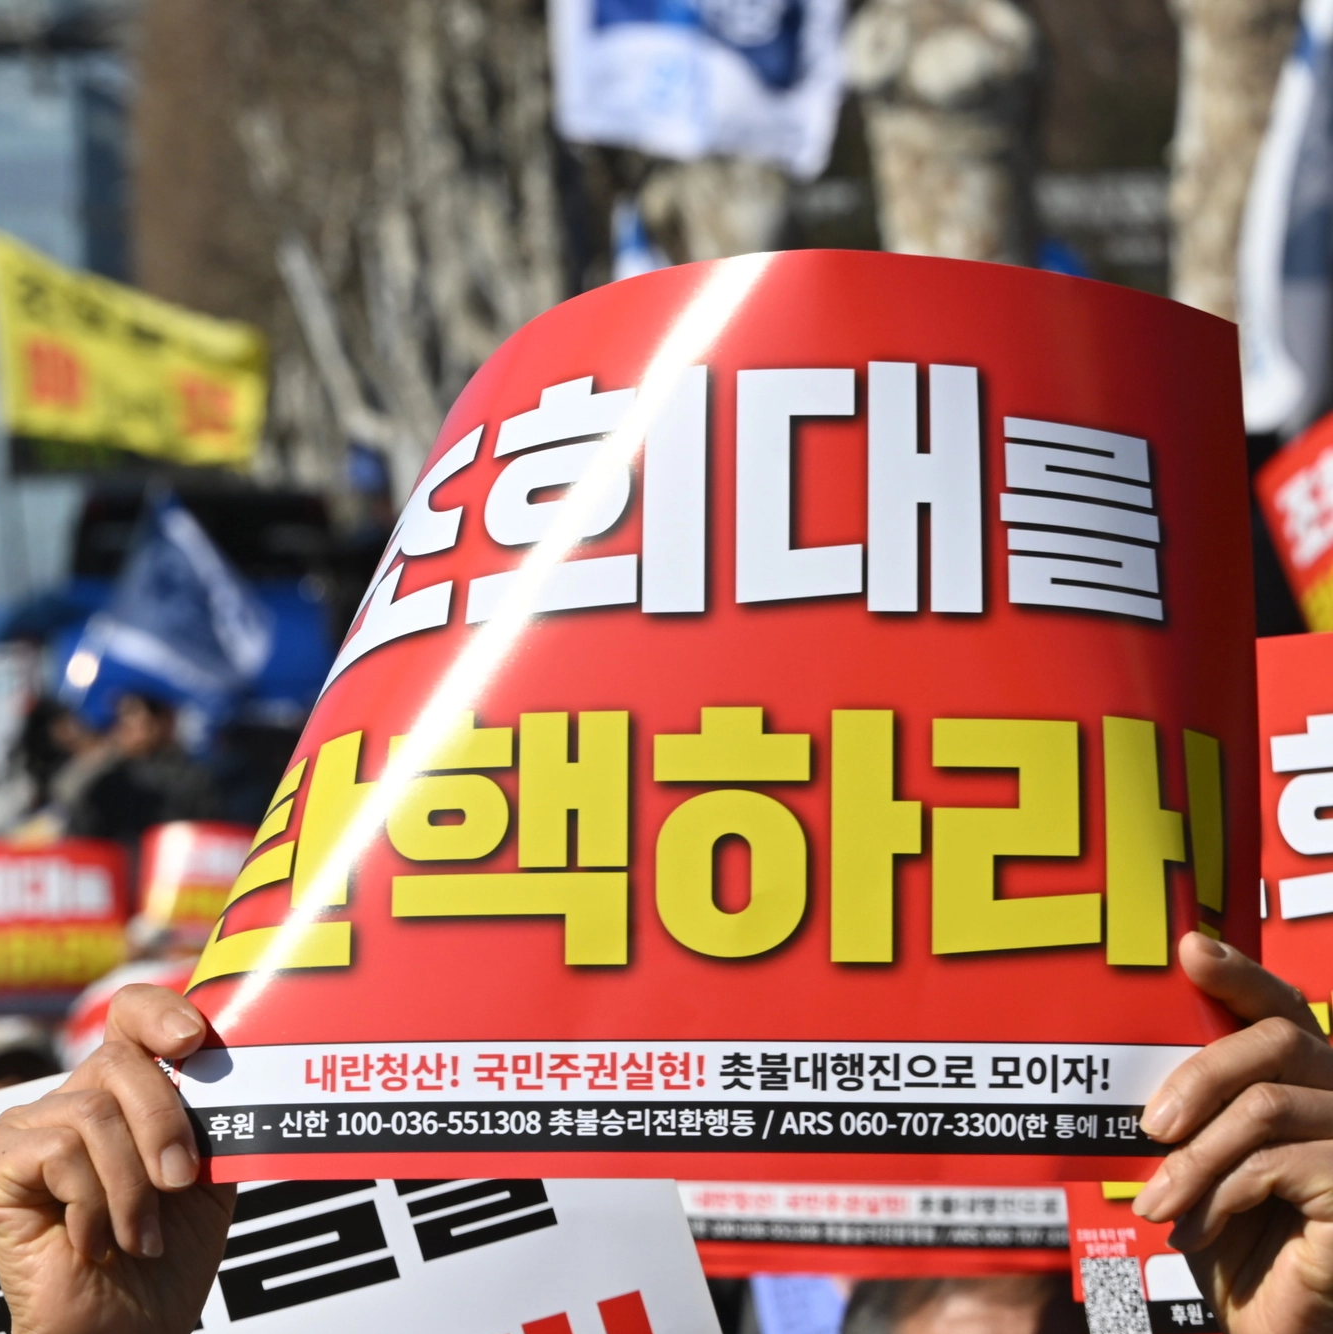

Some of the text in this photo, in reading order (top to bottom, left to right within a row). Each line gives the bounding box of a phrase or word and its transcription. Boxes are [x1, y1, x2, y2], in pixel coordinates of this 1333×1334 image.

[319, 361, 1164, 698] 조희대를
[183, 706, 1223, 996] 탄핵하라!
[208, 1112, 255, 1141] 후원
[279, 1110, 329, 1139] 신한
[336, 1110, 542, 1136] 100-036-551308
[548, 1109, 755, 1139] 촛불승리전환행동
[762, 1110, 775, 1140] /
[780, 1112, 834, 1136] ARS
[839, 1112, 1048, 1141] 060-707-3300(한
[1054, 1114, 1098, 1140] 통에
[303, 1051, 1110, 1093] 내란청산! 국민주권실현! 촛불대행진으로 모이자!
